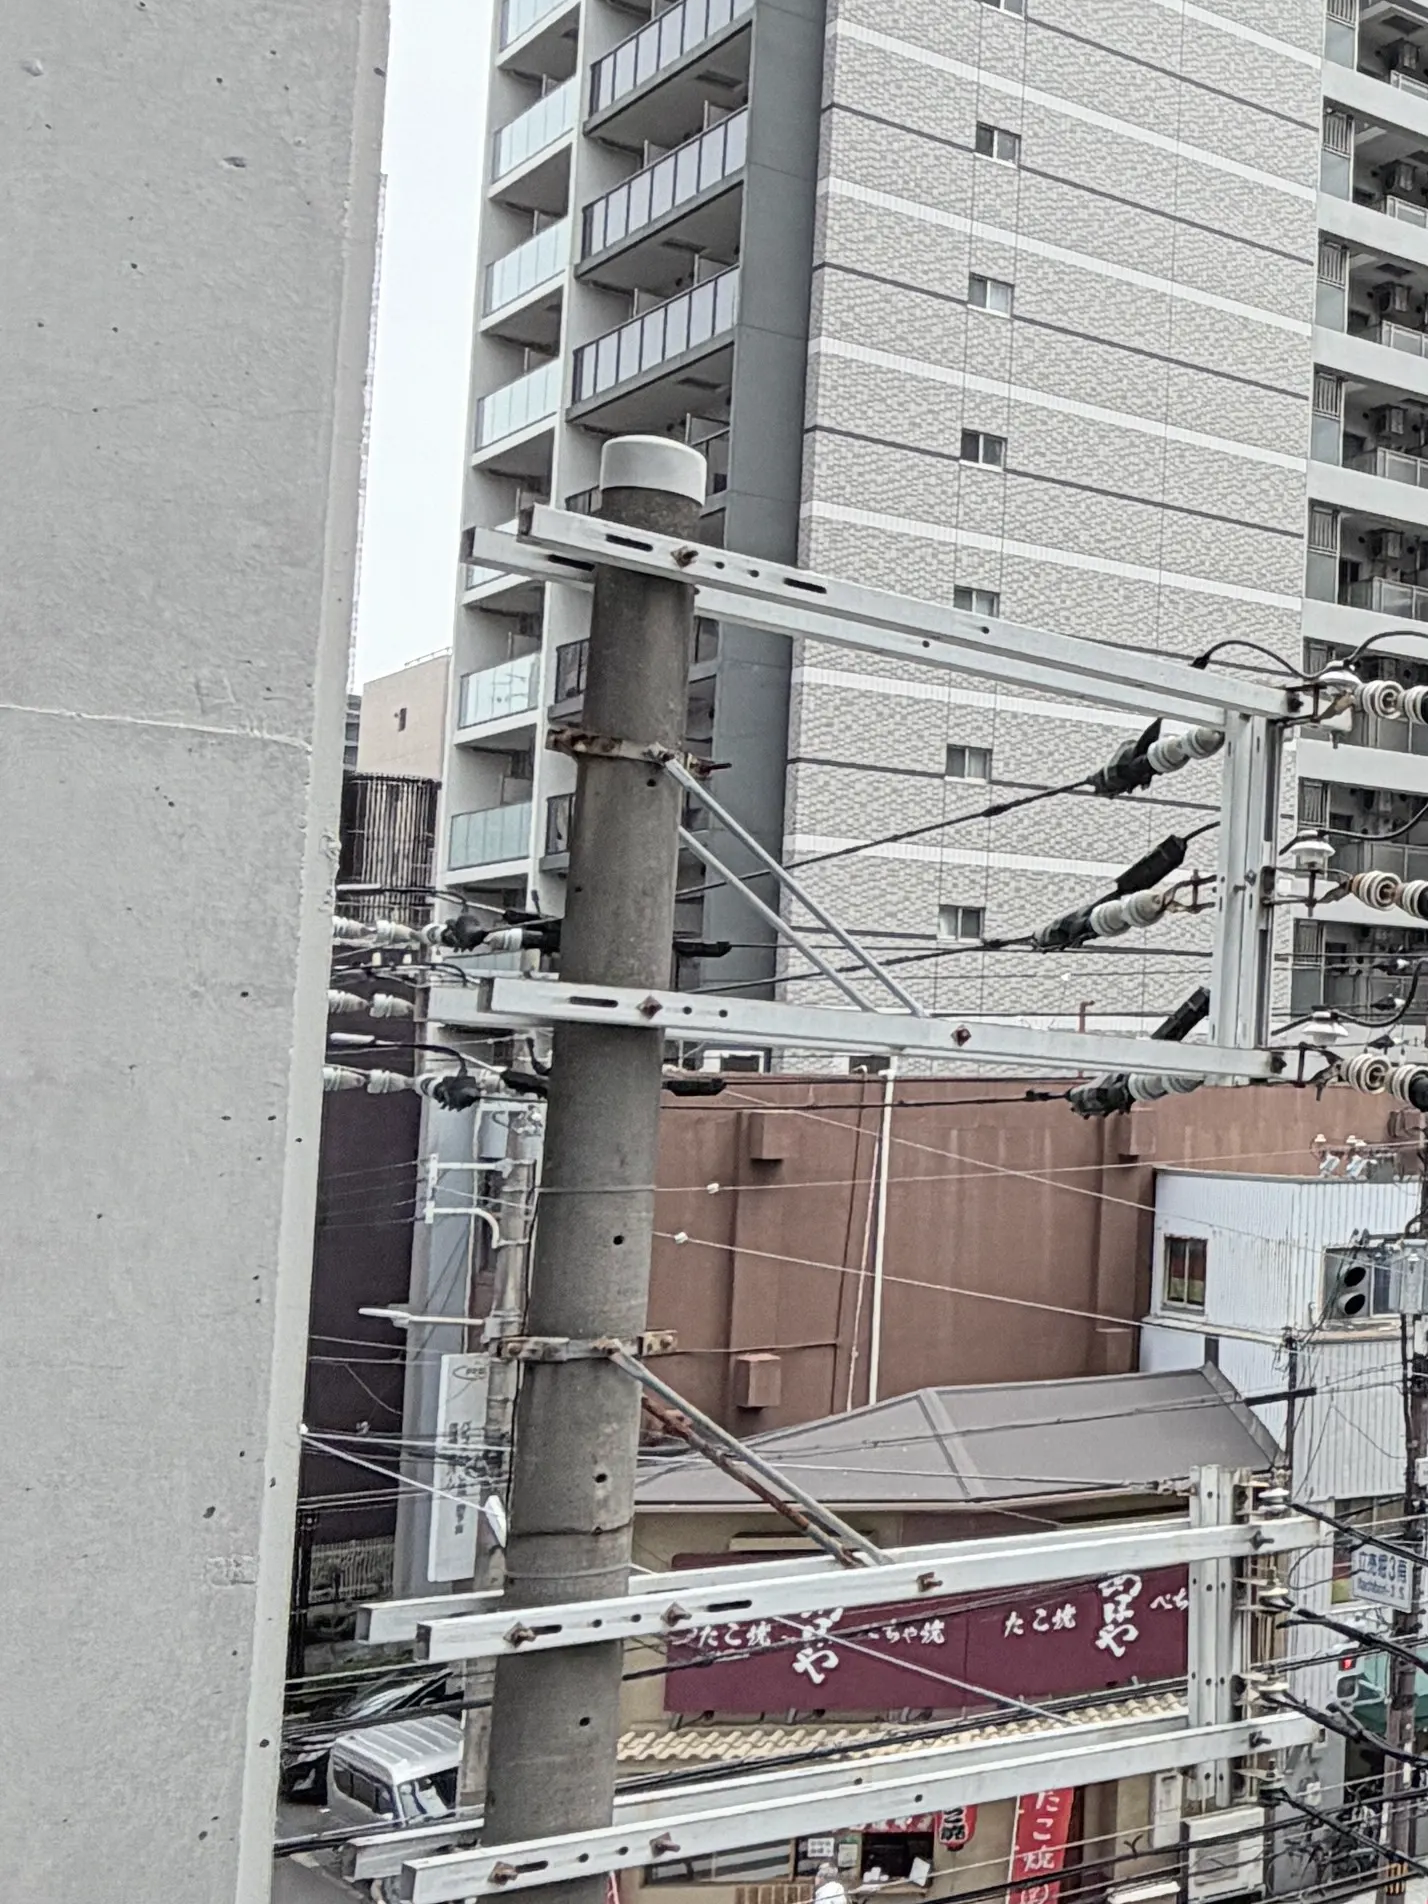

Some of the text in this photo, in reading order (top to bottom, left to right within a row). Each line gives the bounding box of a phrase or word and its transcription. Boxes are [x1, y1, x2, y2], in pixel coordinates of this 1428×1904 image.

[697, 1620, 772, 1648] たこ焼
[1003, 1603, 1078, 1639] たこ焼
[941, 1807, 966, 1841] こ焼
